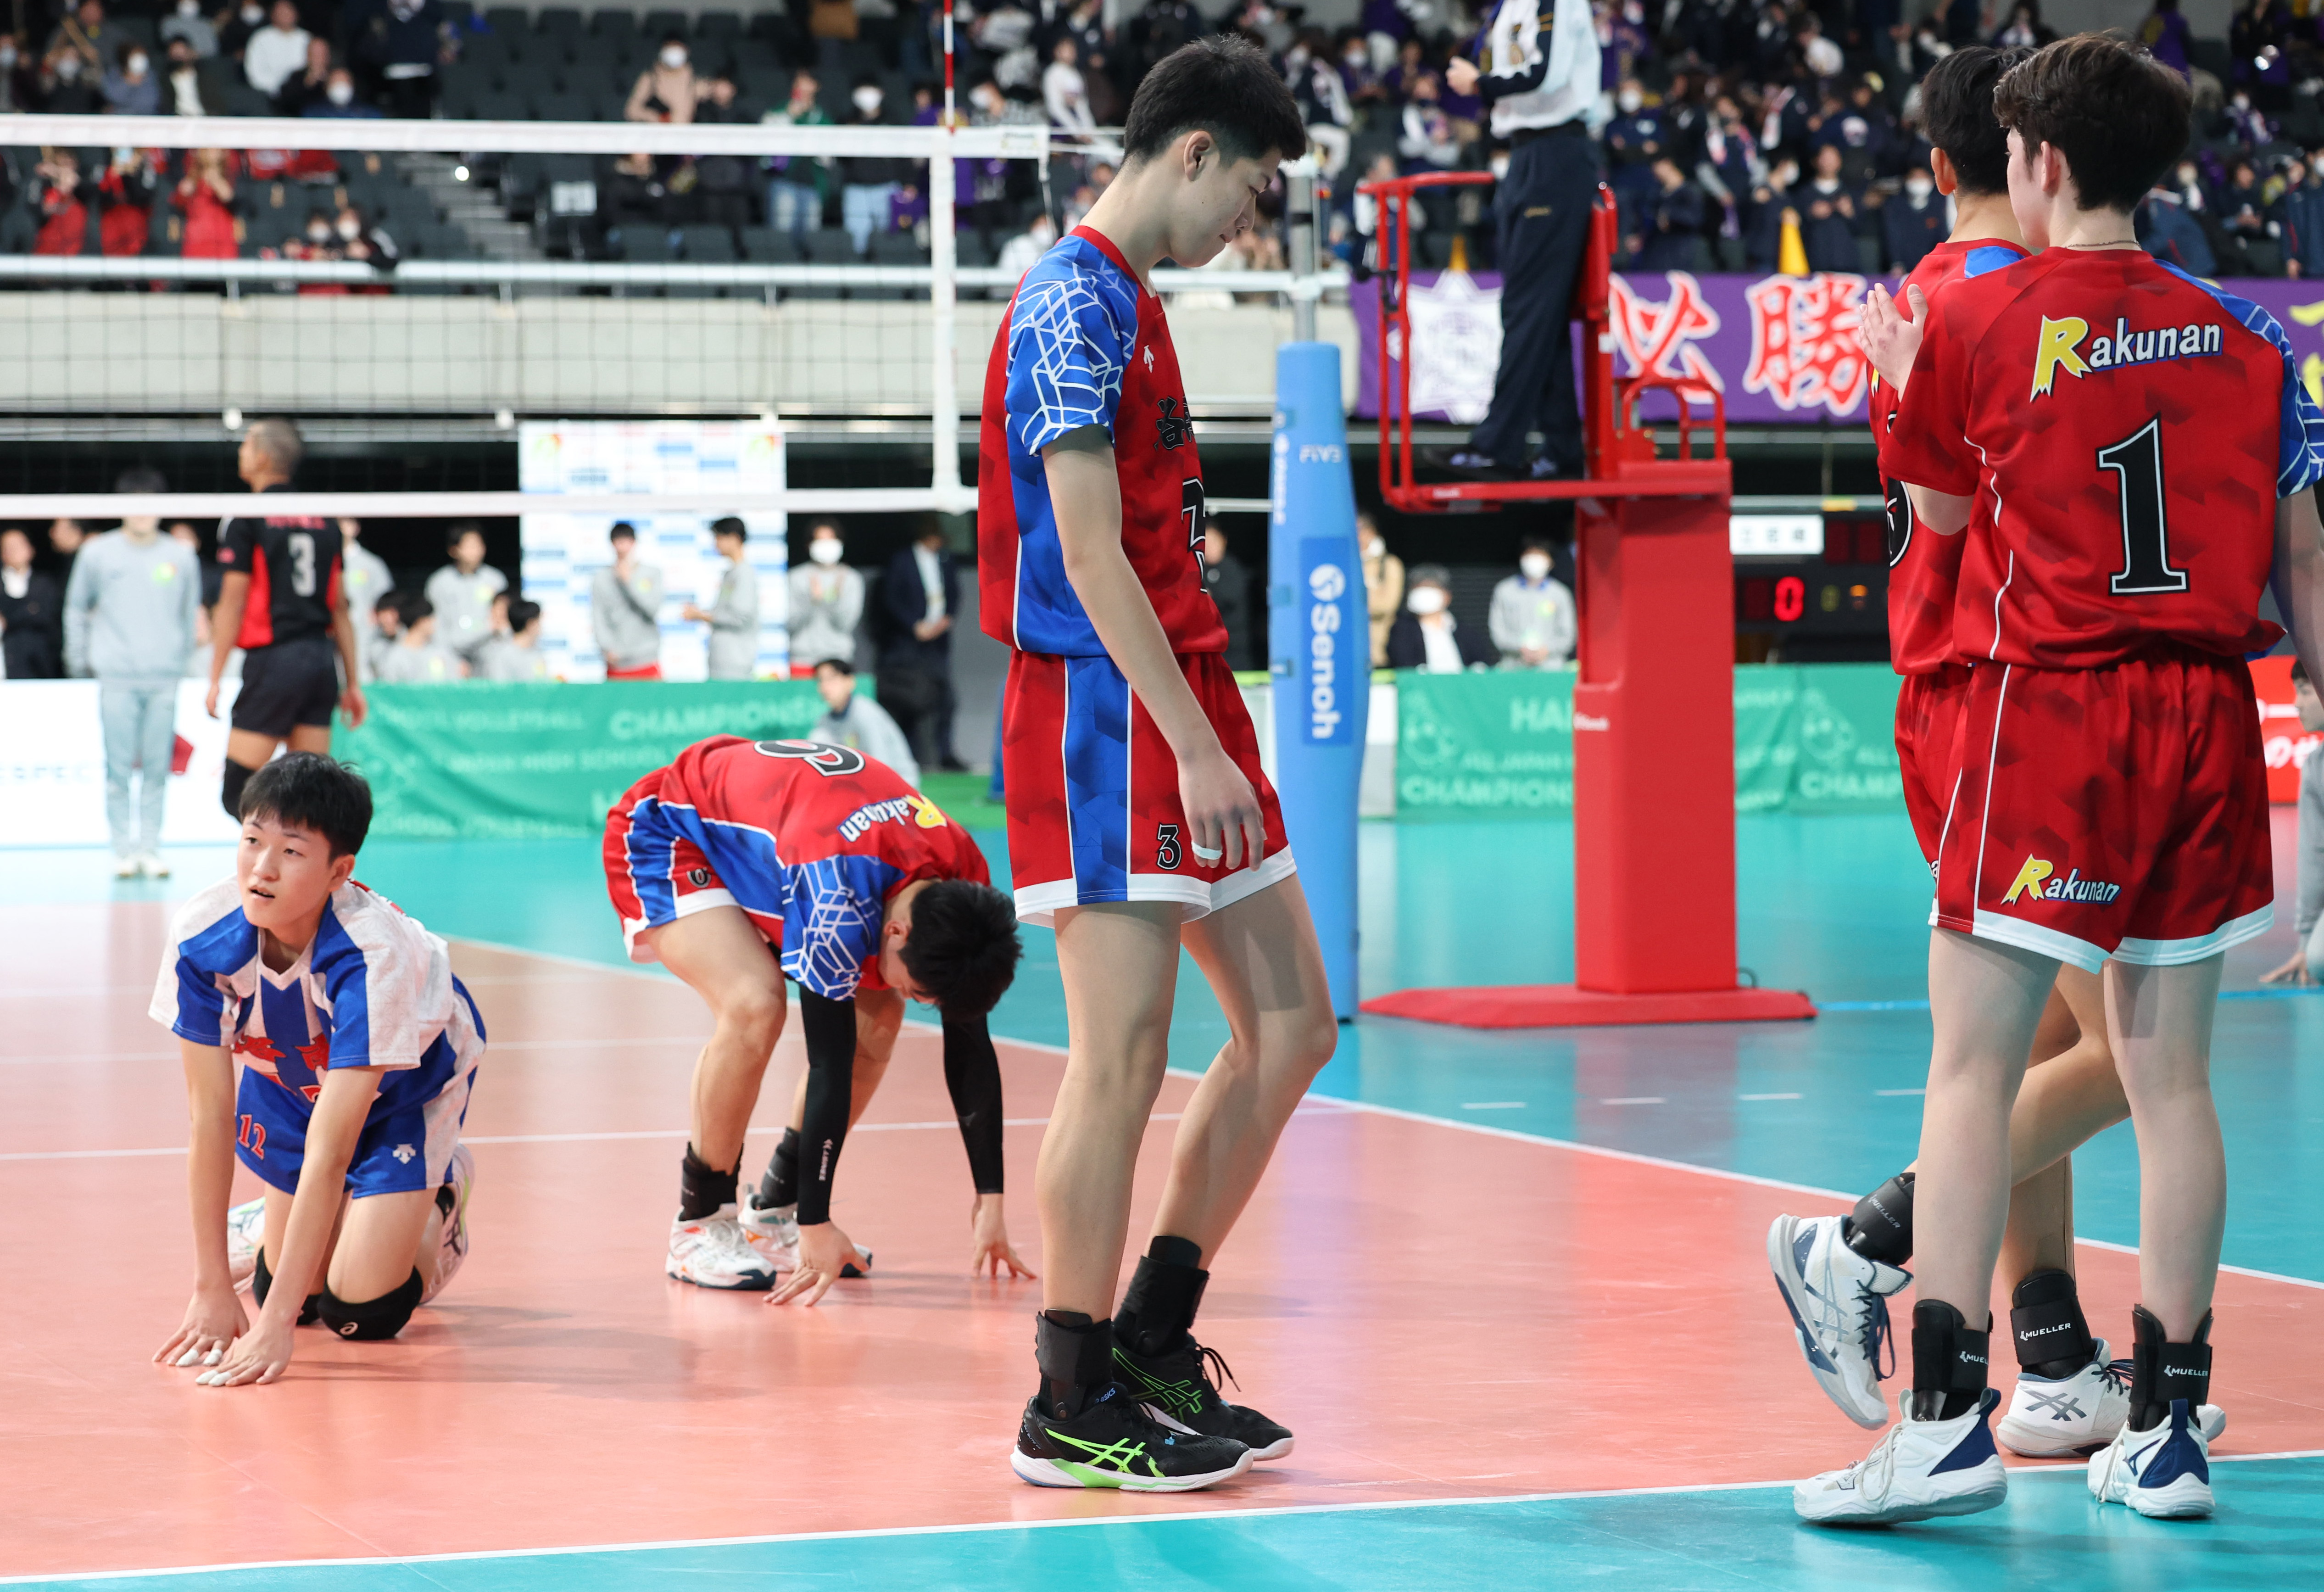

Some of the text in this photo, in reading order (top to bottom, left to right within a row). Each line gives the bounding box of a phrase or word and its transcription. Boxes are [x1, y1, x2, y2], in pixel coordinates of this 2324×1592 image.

[2030, 315, 2224, 403] Rakunan
[2096, 411, 2191, 596] 1
[288, 532, 317, 597] 3
[1773, 576, 1805, 622] 0
[1310, 602, 1342, 740] Senoh
[1401, 776, 1573, 808] CHAMPION
[1800, 771, 1905, 800] CHAMP
[836, 793, 948, 843] Rakunan
[1157, 823, 1182, 870] 3
[2000, 853, 2123, 906] Rakunan
[238, 1114, 267, 1160] 12
[1872, 1196, 1900, 1229] MUELLER
[2025, 1323, 2071, 1338] MUELLER
[1966, 1353, 1989, 1366] MUEL
